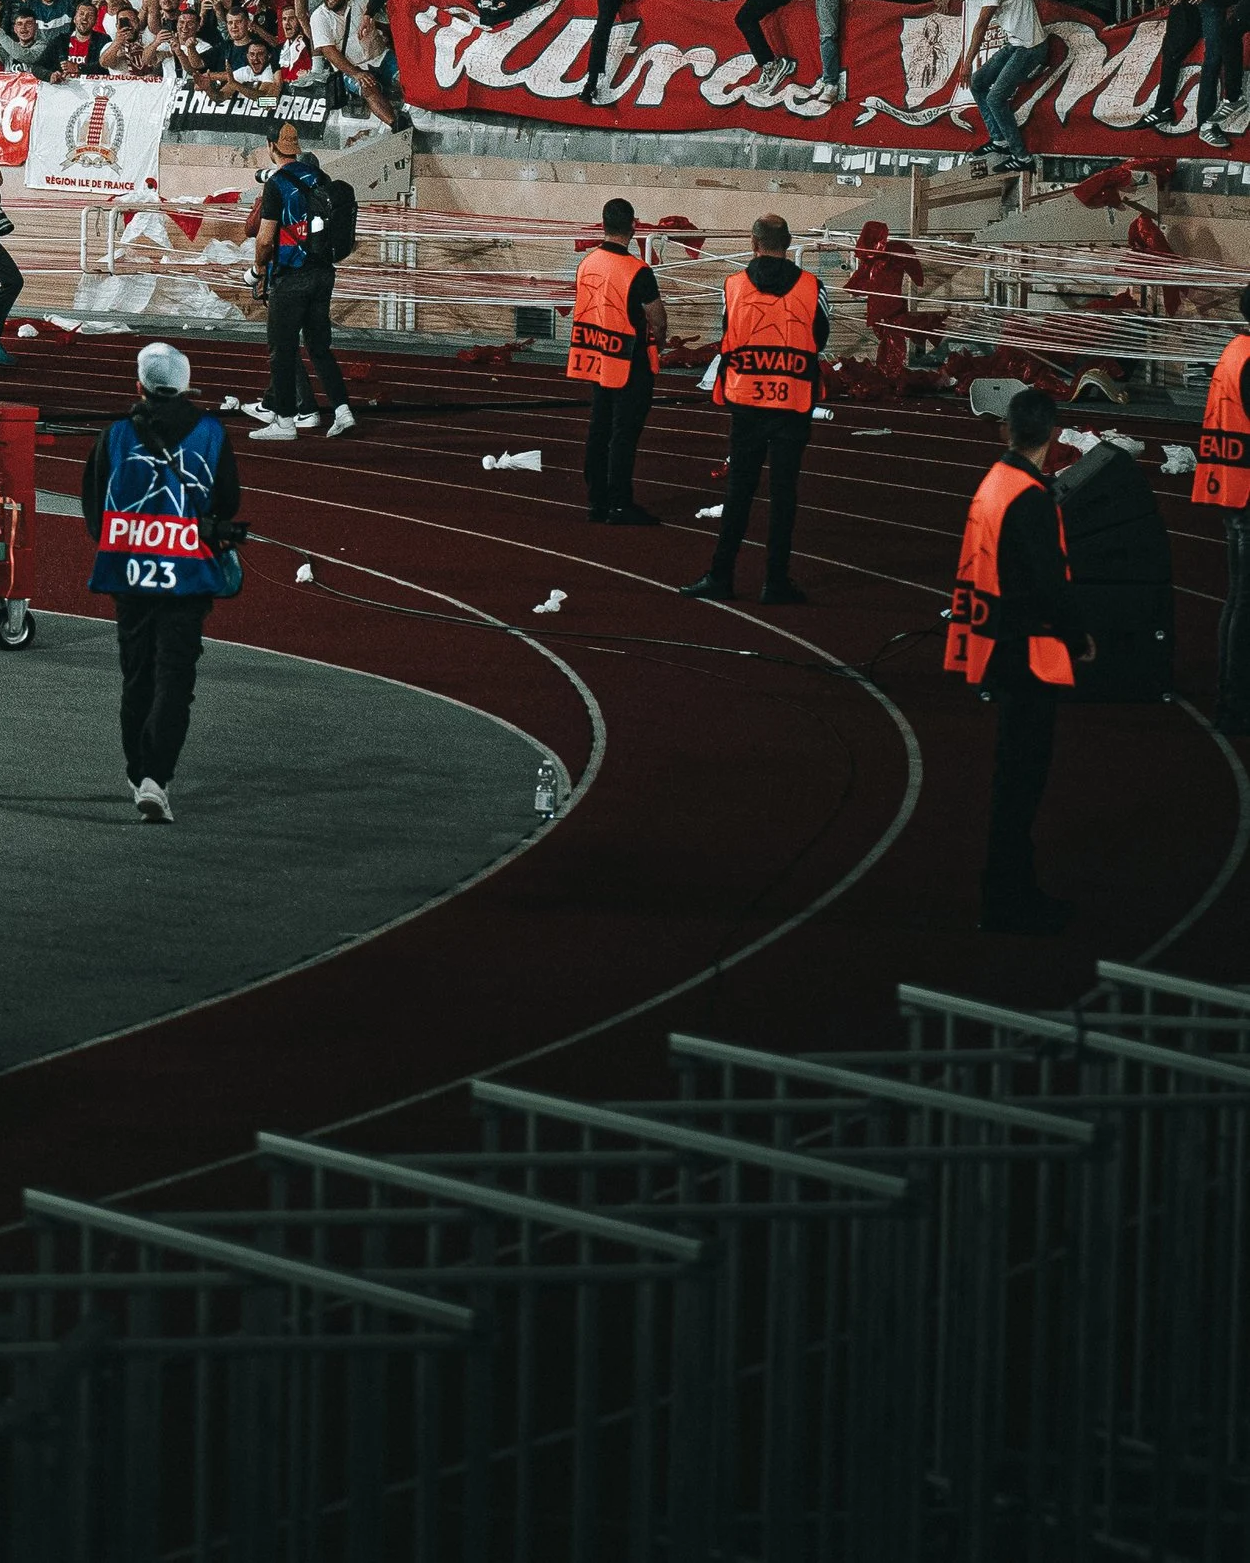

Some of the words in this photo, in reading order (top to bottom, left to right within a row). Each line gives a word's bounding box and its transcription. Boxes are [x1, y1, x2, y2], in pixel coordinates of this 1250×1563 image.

[46, 175, 77, 188] RÉGION
[92, 179, 102, 188] DE
[103, 180, 135, 191] FRANCE
[752, 381, 788, 402] 338
[108, 517, 199, 551] PHOTO
[126, 558, 177, 589] 023
